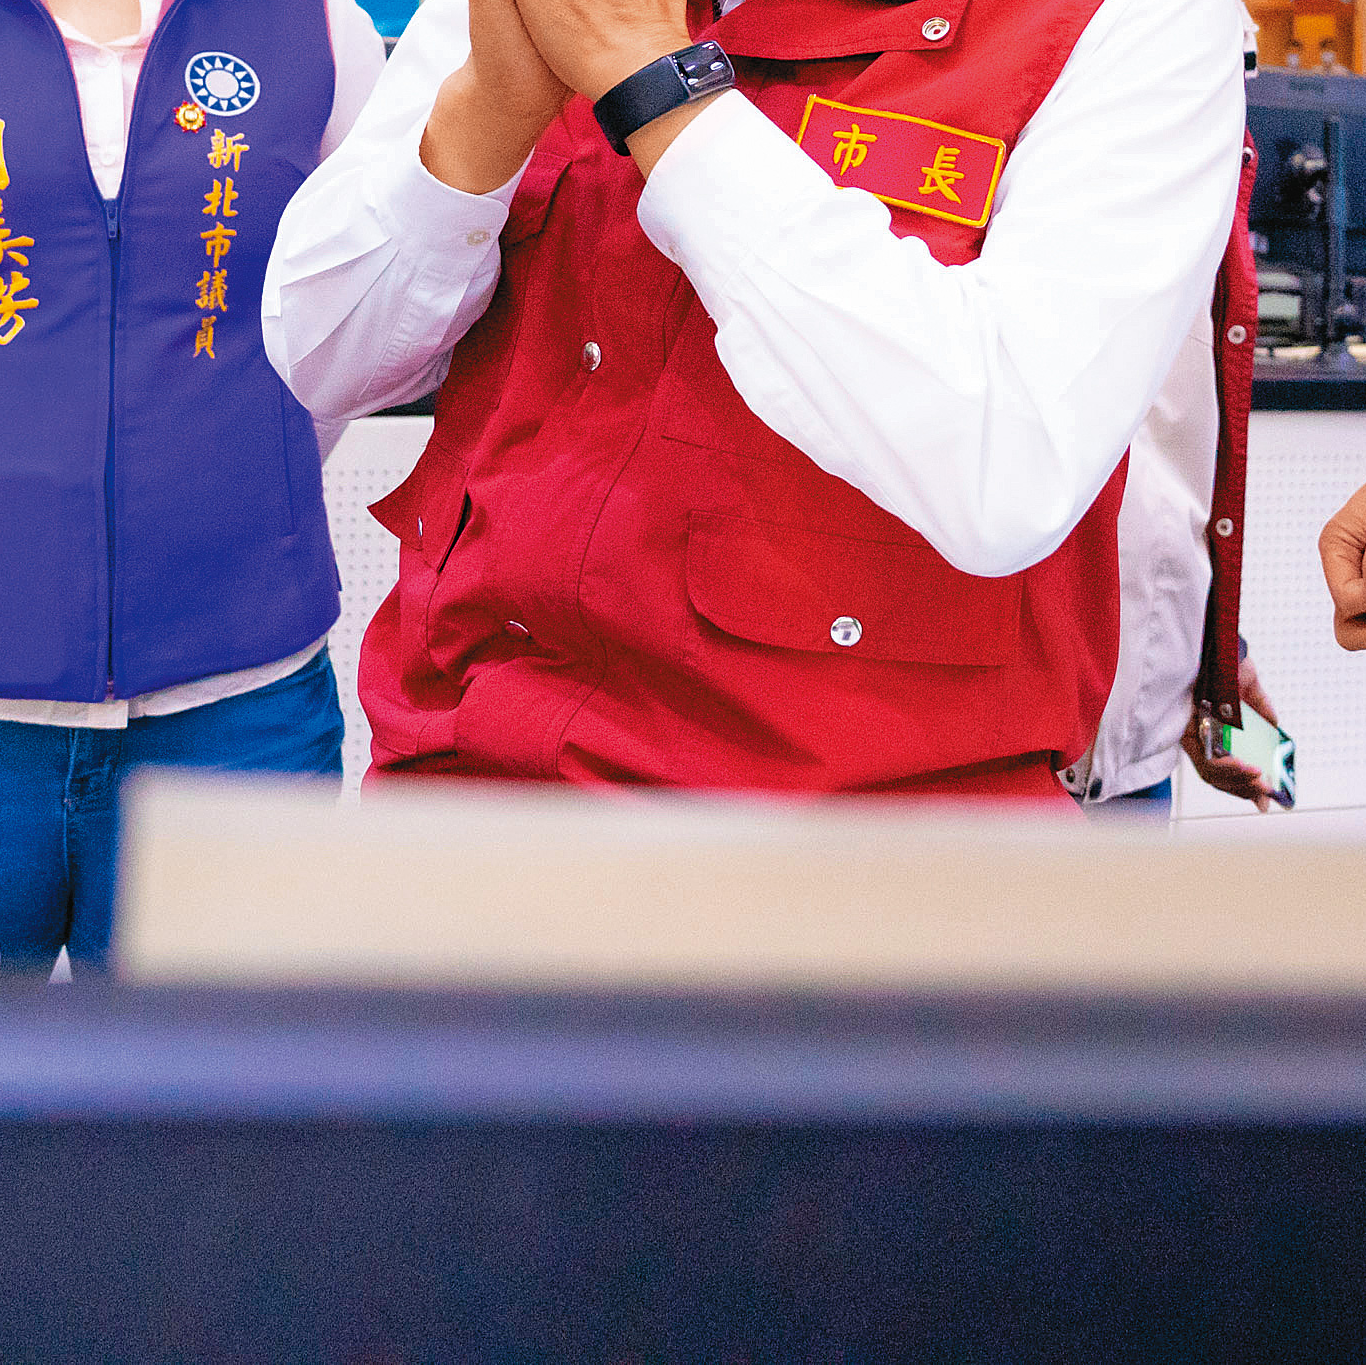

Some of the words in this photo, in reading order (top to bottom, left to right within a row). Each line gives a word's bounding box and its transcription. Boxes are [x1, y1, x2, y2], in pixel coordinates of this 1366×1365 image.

[832, 122, 966, 205] 市長
[191, 128, 251, 360] 新北市議員
